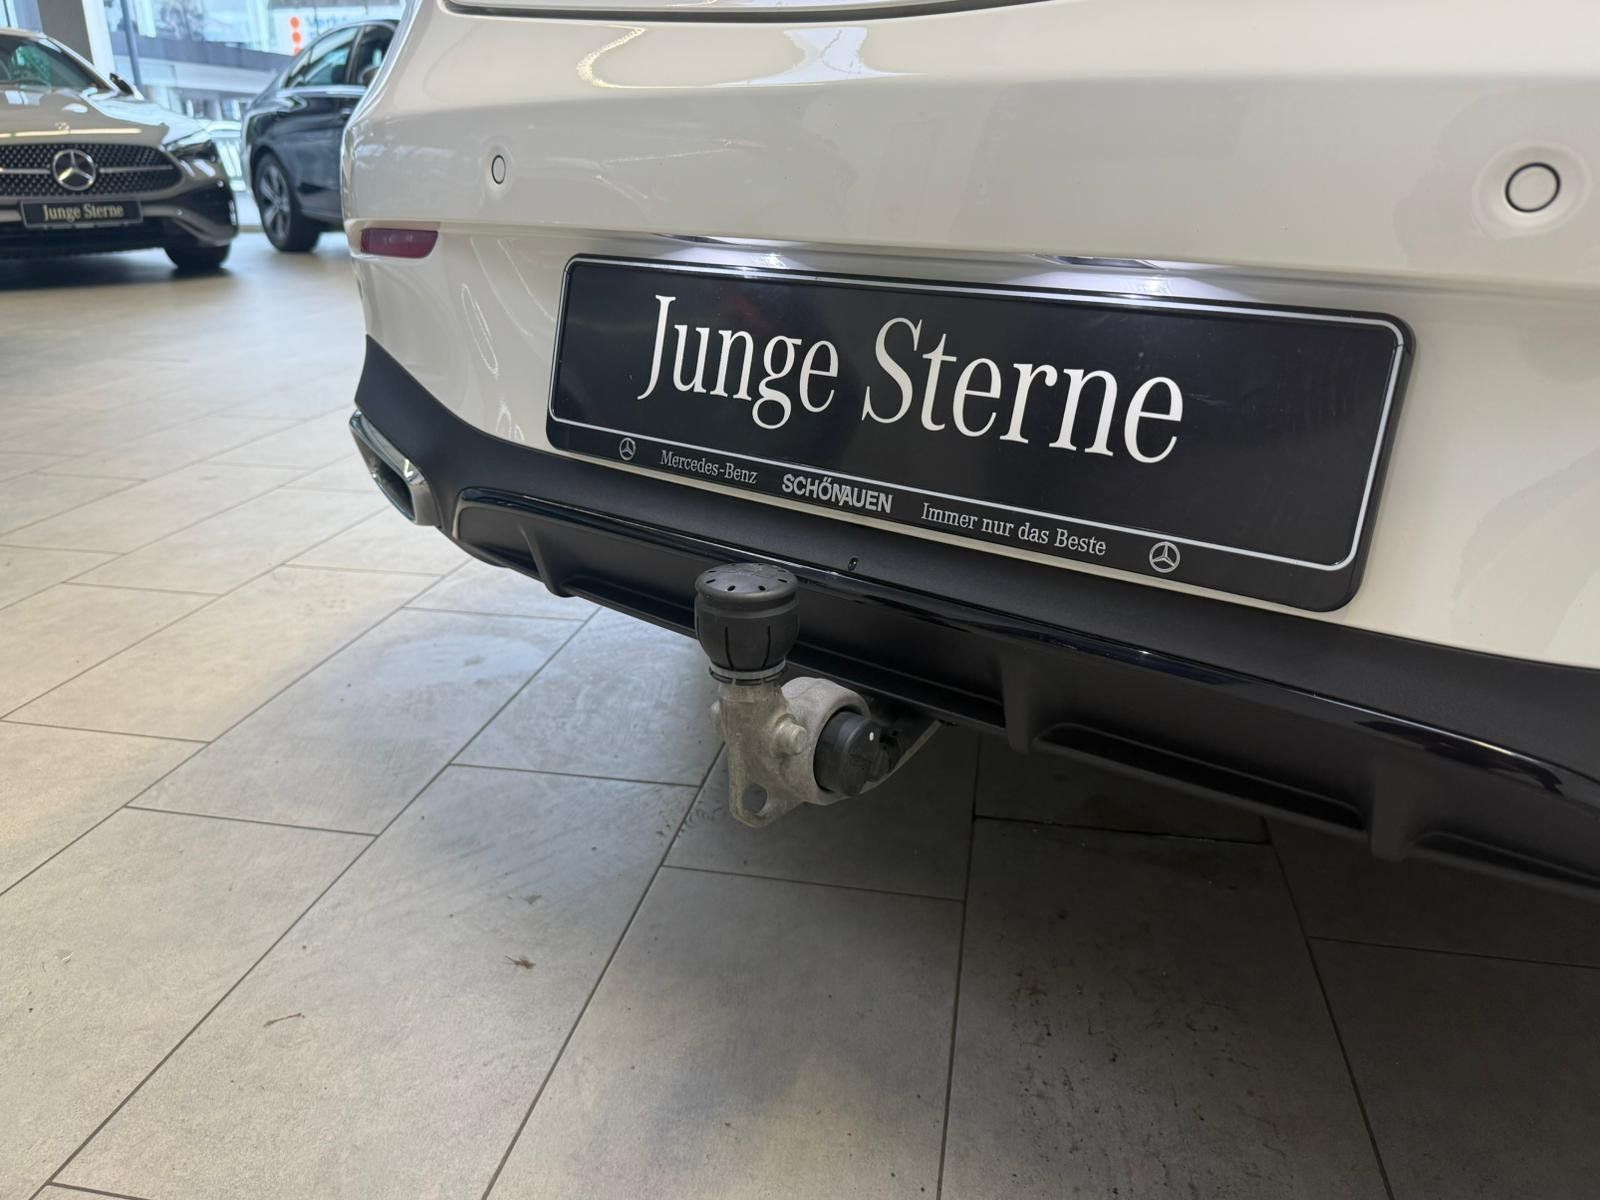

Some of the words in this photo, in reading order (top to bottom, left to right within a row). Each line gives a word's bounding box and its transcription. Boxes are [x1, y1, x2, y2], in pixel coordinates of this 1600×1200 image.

[43, 204, 81, 223] Junge
[83, 203, 124, 219] Sterne
[637, 294, 839, 430] Junge
[861, 317, 1184, 464] Sterne
[660, 450, 758, 484] Mercedes-Benz
[781, 474, 894, 514] SCHÖNAUEN
[920, 502, 978, 530] Immer
[981, 517, 1014, 537] nur
[1017, 522, 1050, 544] das
[1054, 527, 1107, 557] Beste
